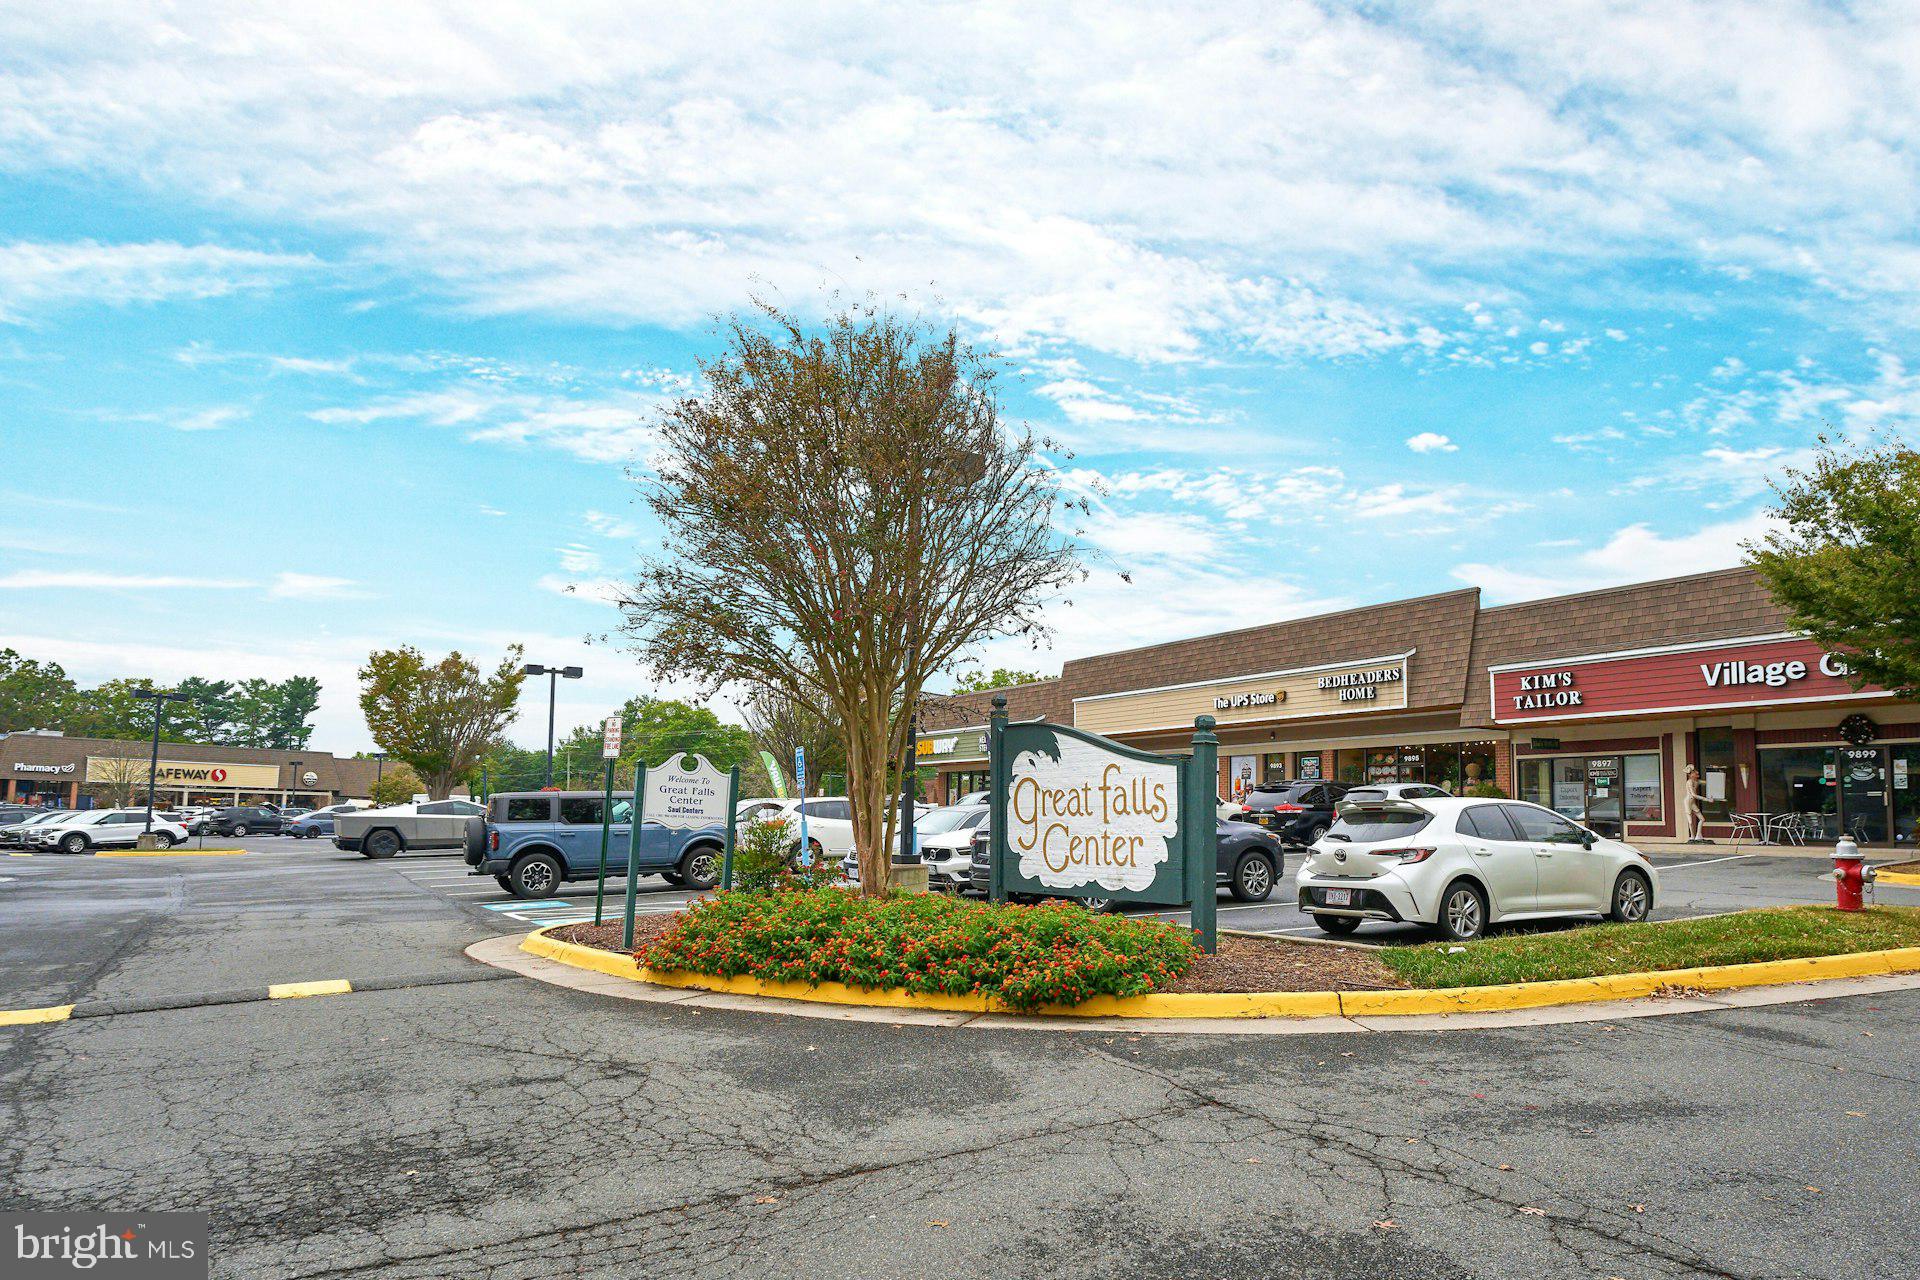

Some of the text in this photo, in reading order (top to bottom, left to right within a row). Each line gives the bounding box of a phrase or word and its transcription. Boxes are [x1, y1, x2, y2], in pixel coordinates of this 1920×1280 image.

[1317, 667, 1400, 689] BEDHEADERS
[1700, 660, 1806, 687] Village
[1520, 671, 1572, 690] KIM'S
[1339, 686, 1375, 701] HOME
[1213, 692, 1275, 709] The UPS Store
[1513, 690, 1582, 710] TAILOR
[915, 736, 959, 757] SUBWAY
[1404, 754, 1420, 762] 9895
[1848, 750, 1877, 759] 9899
[14, 763, 60, 774] Pharmacy
[1591, 760, 1612, 768] 9897
[156, 768, 210, 780] AFEWAY
[667, 775, 711, 785] Welcome To
[659, 785, 715, 797] Great Falls
[669, 795, 704, 805] Center
[667, 805, 704, 815] Saul Centers
[1043, 822, 1144, 873] Center
